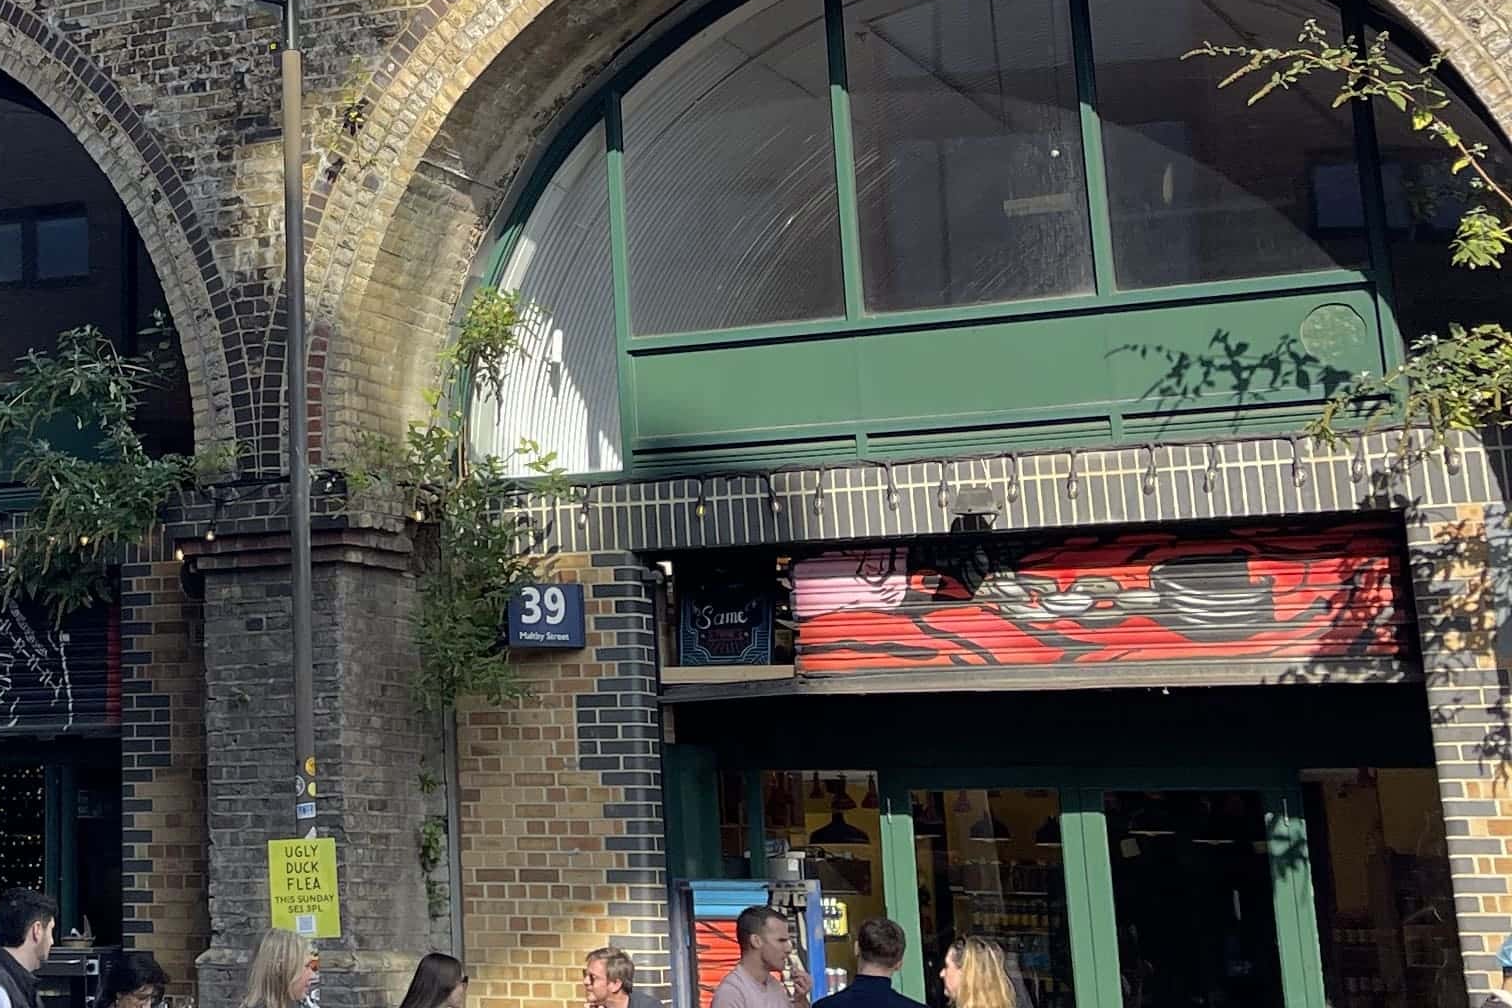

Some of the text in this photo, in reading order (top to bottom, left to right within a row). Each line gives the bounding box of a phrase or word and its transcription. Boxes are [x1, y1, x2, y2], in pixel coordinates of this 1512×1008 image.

[521, 586, 566, 625] 39
[284, 844, 319, 858] UGLY
[286, 861, 319, 874] DUCK
[287, 877, 321, 890] FLEA
[274, 894, 334, 904] THIS SUNDAY
